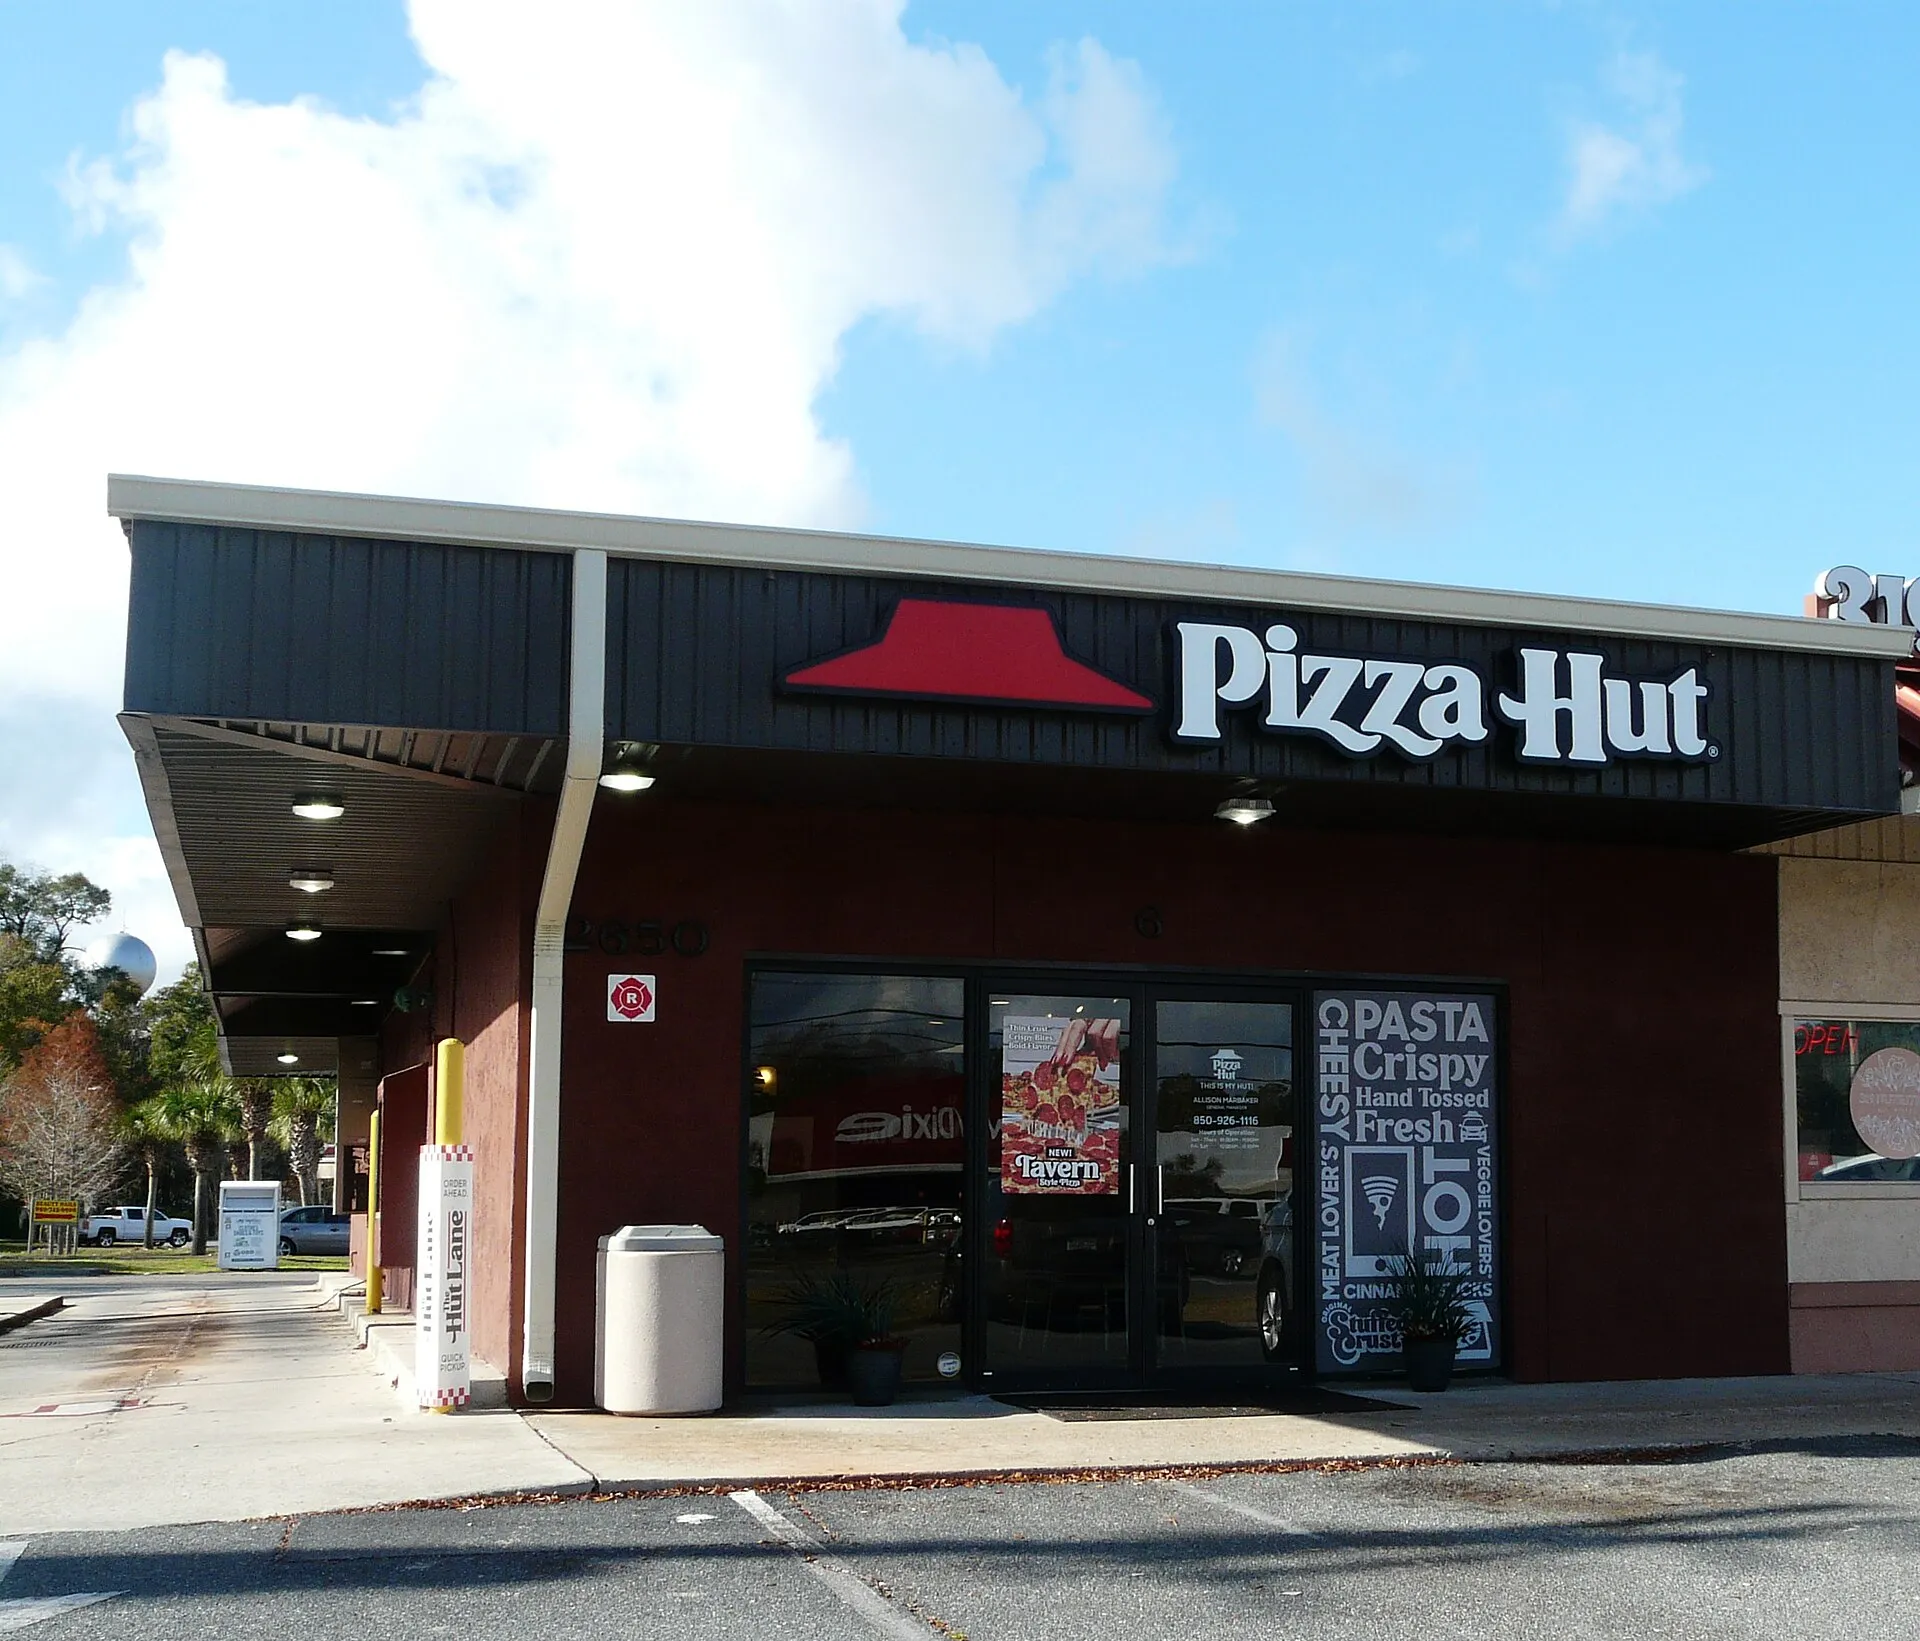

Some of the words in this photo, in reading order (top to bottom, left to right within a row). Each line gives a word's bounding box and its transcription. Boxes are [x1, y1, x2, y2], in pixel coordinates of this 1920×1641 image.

[1816, 564, 1920, 628] 31
[1176, 621, 1489, 756] Pizza
[1499, 647, 1708, 763] Hut
[626, 992, 638, 1004] R
[1008, 1024, 1027, 1032] Thin
[1354, 999, 1489, 1042] PASTA
[1008, 1033, 1033, 1042] Crispy
[1008, 1042, 1027, 1050] Bold
[1794, 1025, 1860, 1056] OPEN
[1213, 1058, 1241, 1071] Pizza
[1213, 1068, 1236, 1080] Hut
[1318, 998, 1350, 1142] CHEESY
[1353, 1041, 1489, 1090] Crispy
[1200, 1082, 1216, 1090] THIS
[1216, 1082, 1224, 1090] IS
[1224, 1082, 1236, 1090] MY
[1354, 1086, 1413, 1107] Hand
[1417, 1087, 1490, 1108] Tossed
[1192, 1096, 1222, 1104] ALLISON
[1193, 1115, 1260, 1126] 850-926-1116
[1354, 1109, 1455, 1143] Fresh
[1048, 1148, 1073, 1158] NEW!
[1015, 1154, 1100, 1179] Tavern
[1475, 1144, 1492, 1208] VEGGIE
[443, 1179, 468, 1188] ORDER
[1039, 1178, 1058, 1187] Style
[1059, 1178, 1080, 1188] Pizza
[1422, 1145, 1472, 1277] HOT
[446, 1210, 463, 1281] Lane
[1320, 1241, 1341, 1300] MEAT
[446, 1283, 462, 1343] Hut
[1320, 1301, 1353, 1323] ORIGINAL
[440, 1353, 464, 1362] QUICK
[1331, 1333, 1404, 1366] Crust
